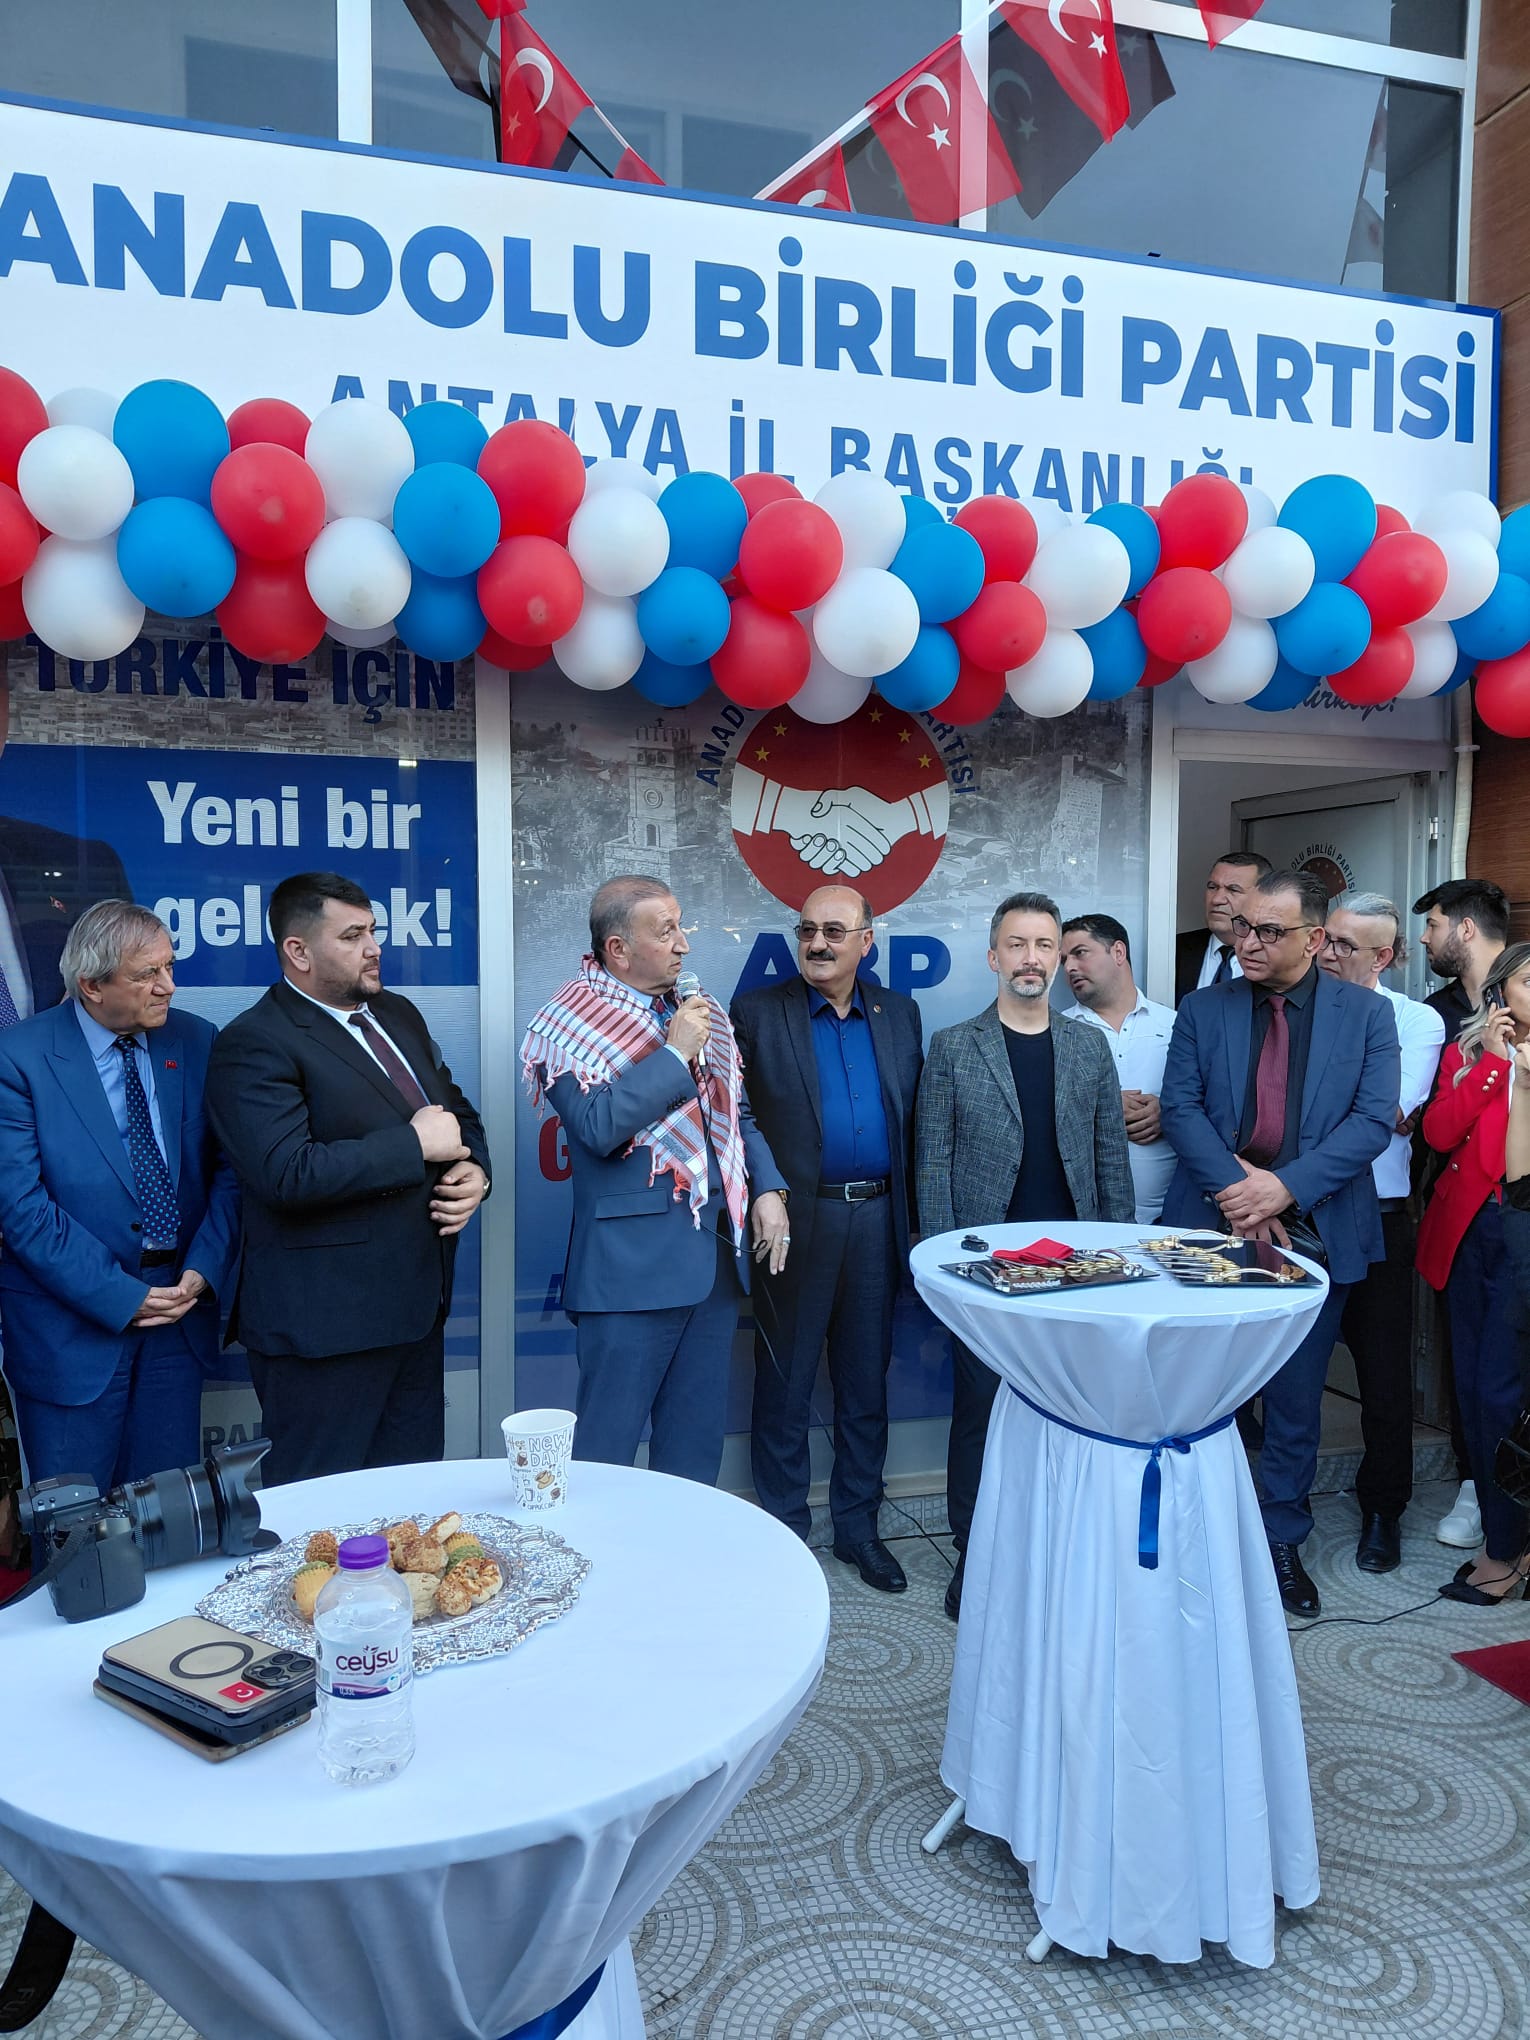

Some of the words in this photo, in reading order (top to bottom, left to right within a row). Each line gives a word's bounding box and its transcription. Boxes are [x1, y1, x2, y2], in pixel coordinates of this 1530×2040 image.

[0, 171, 651, 348] ANADOLU
[694, 235, 1085, 398] BİRLİĞİ
[1121, 315, 1476, 444] PARTİSİ
[729, 398, 795, 483] İL
[830, 426, 1253, 522] BAŞKANL
[332, 634, 455, 724] İÇİN
[146, 780, 300, 848] Yeni
[326, 787, 423, 850] bir
[153, 885, 452, 961] gelk!
[335, 1645, 399, 1676] ceysu
